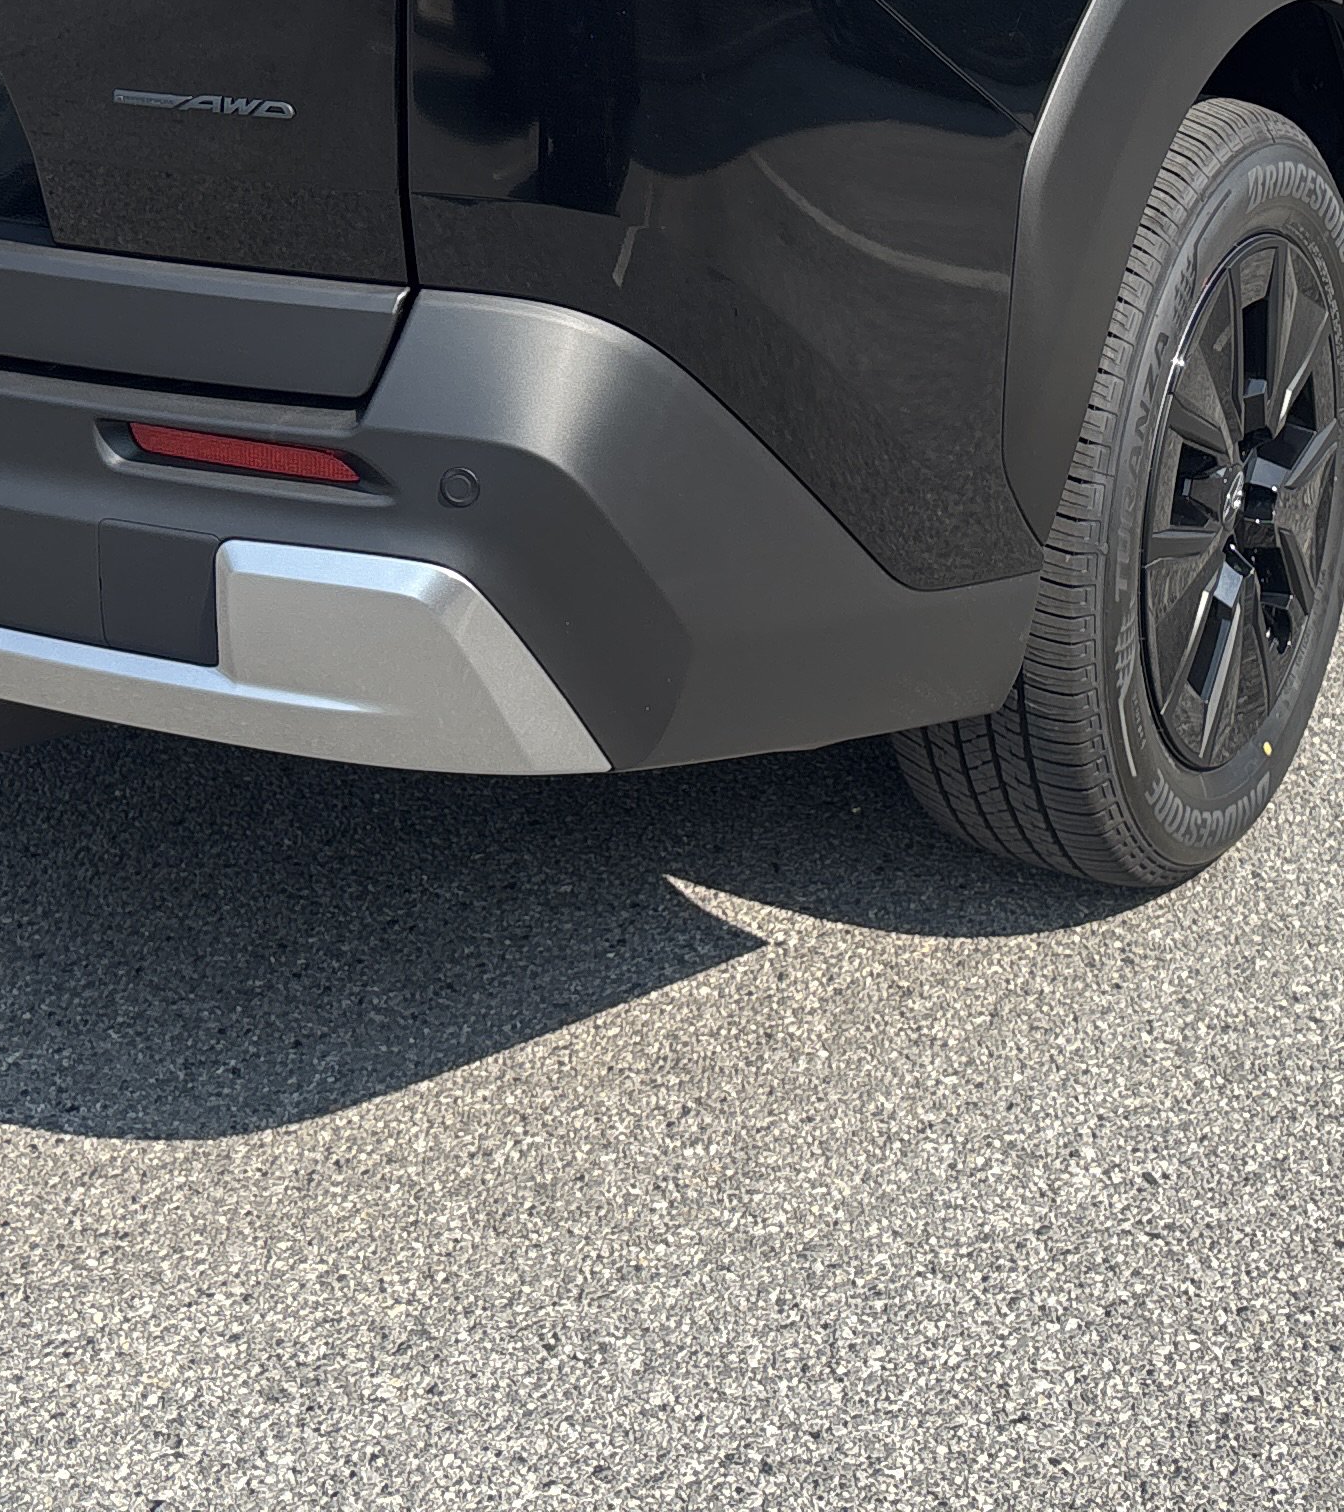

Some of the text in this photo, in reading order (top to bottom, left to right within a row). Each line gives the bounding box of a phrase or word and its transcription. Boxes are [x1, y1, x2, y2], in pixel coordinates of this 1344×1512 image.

[178, 94, 296, 119] AWD
[1114, 331, 1170, 603] TURANZA
[1144, 767, 1271, 849] BRIDGESTONE
